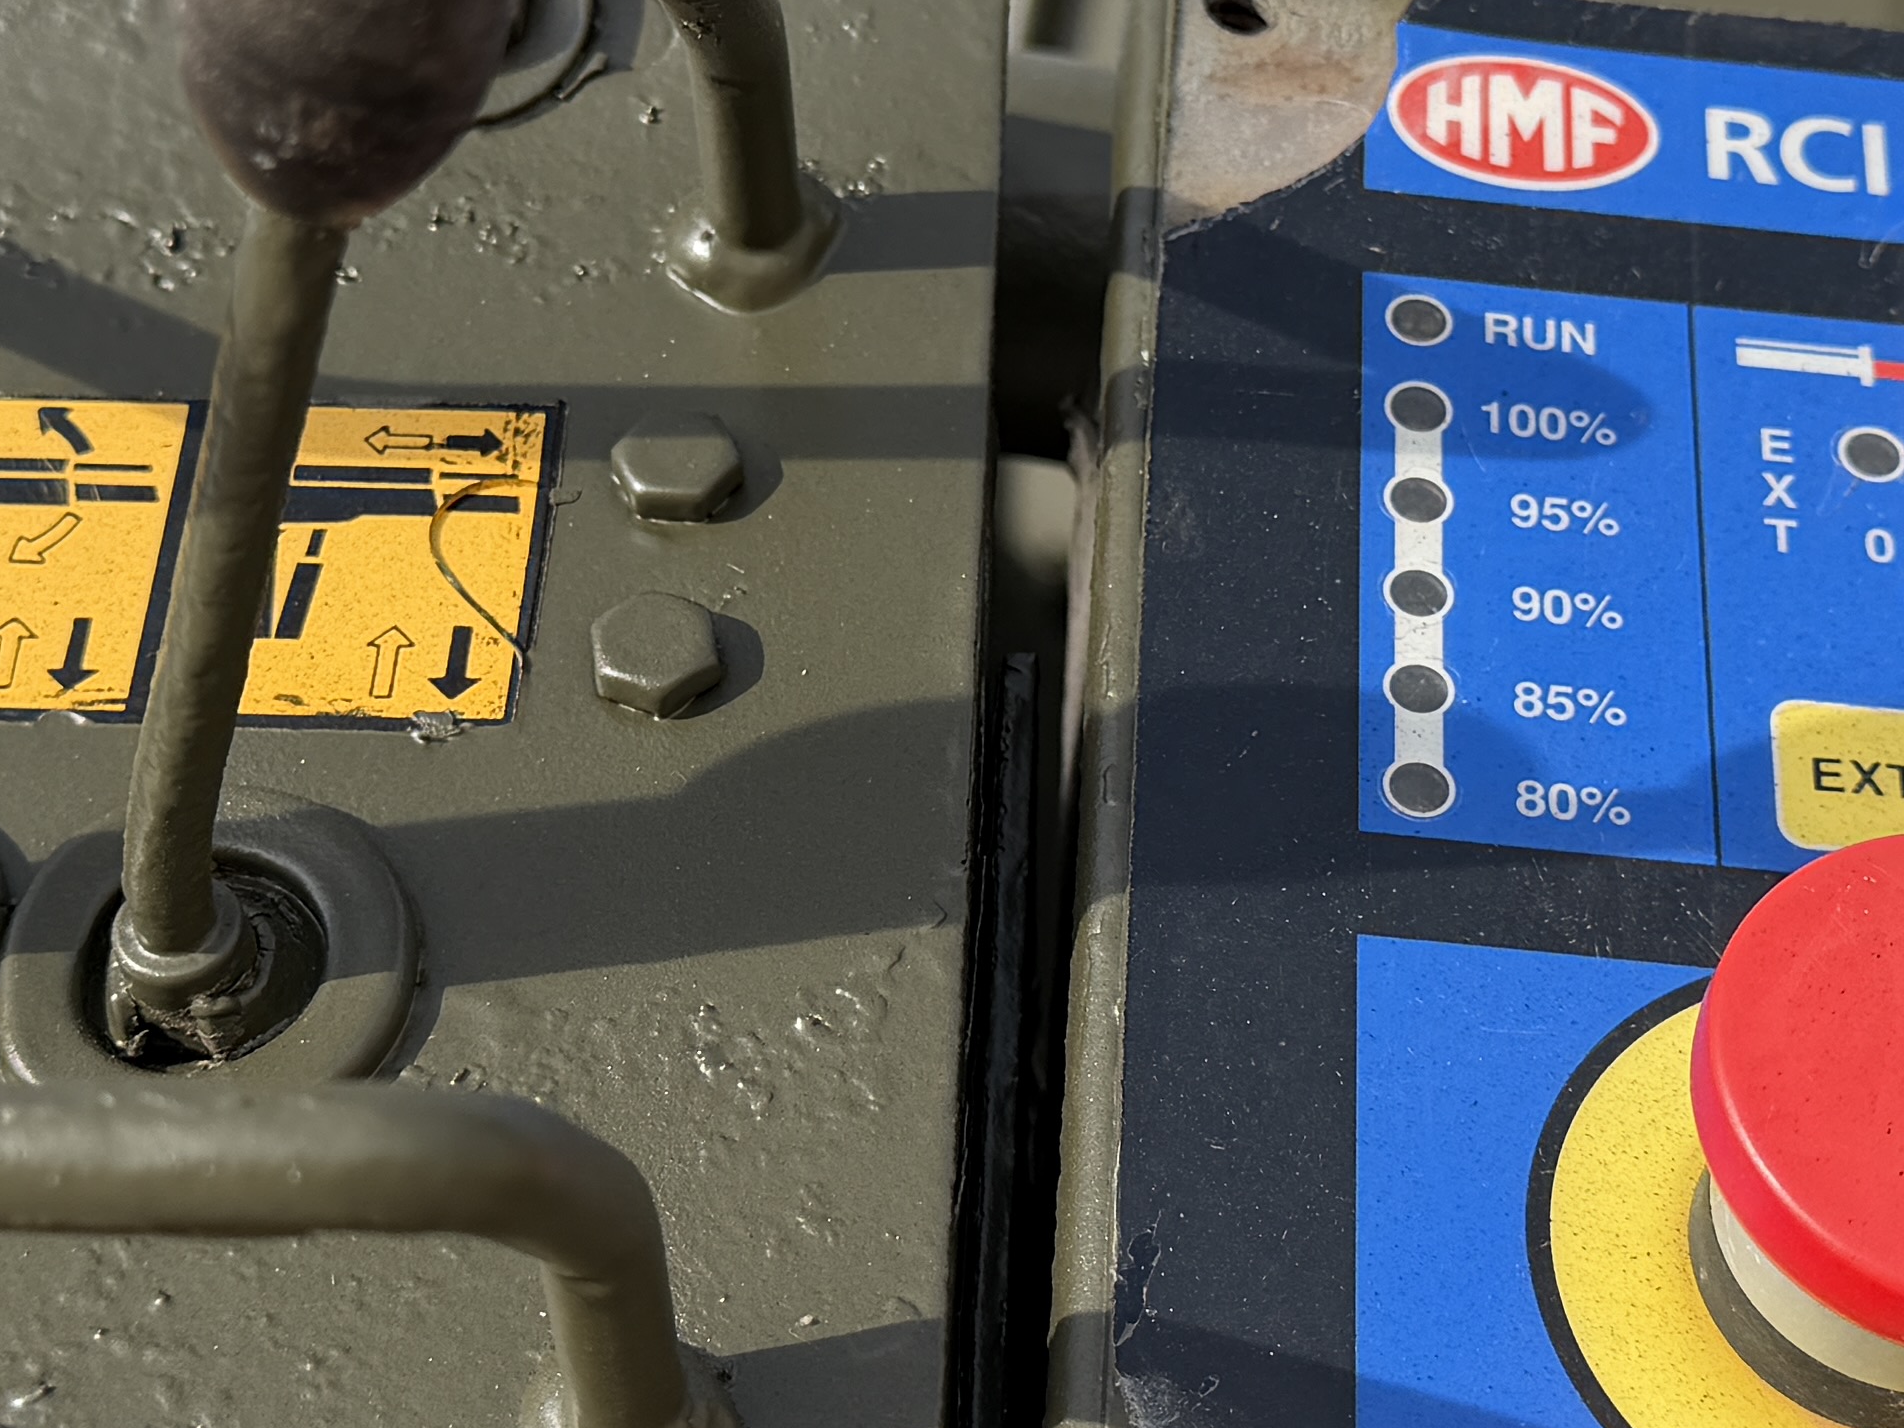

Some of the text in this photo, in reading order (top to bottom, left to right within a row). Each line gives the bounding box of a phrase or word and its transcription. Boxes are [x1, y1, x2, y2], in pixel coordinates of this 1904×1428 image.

[1425, 72, 1627, 171] HMF
[1705, 107, 1890, 196] RCI
[1484, 311, 1597, 356] RUN
[1481, 401, 1618, 447] 100%
[1760, 427, 1799, 553] EXT
[1509, 492, 1621, 538] 95%
[1864, 528, 1896, 564] 0
[1511, 584, 1624, 631] 90%
[1512, 681, 1628, 728] 85%
[1515, 779, 1632, 826] 80%
